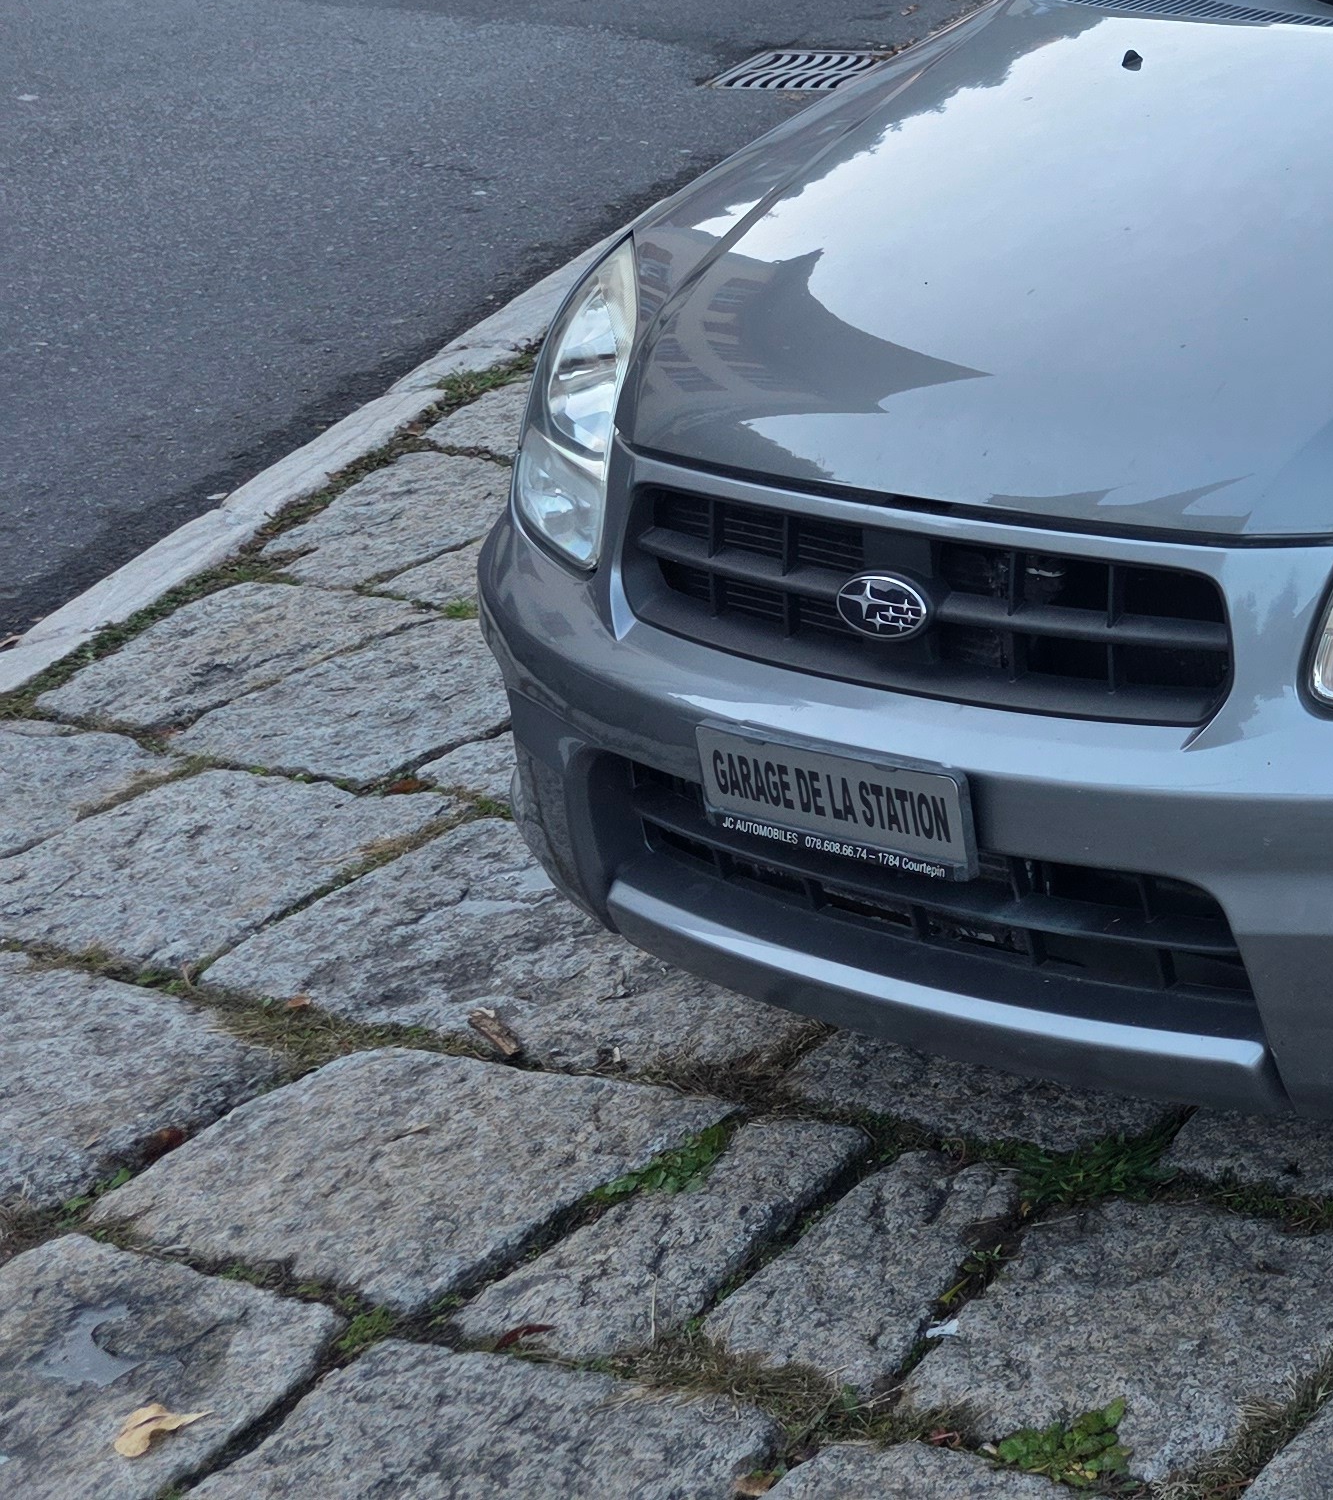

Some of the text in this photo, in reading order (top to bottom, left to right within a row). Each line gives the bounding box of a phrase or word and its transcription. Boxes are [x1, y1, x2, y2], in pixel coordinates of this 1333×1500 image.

[712, 749, 952, 843] GARAGE DE LA STATION
[722, 816, 734, 829] JC
[735, 819, 799, 845] AUTOMOBILES
[804, 835, 868, 860] 078.608.66.74
[878, 852, 900, 868] 1784
[901, 857, 946, 878] Courtepin
